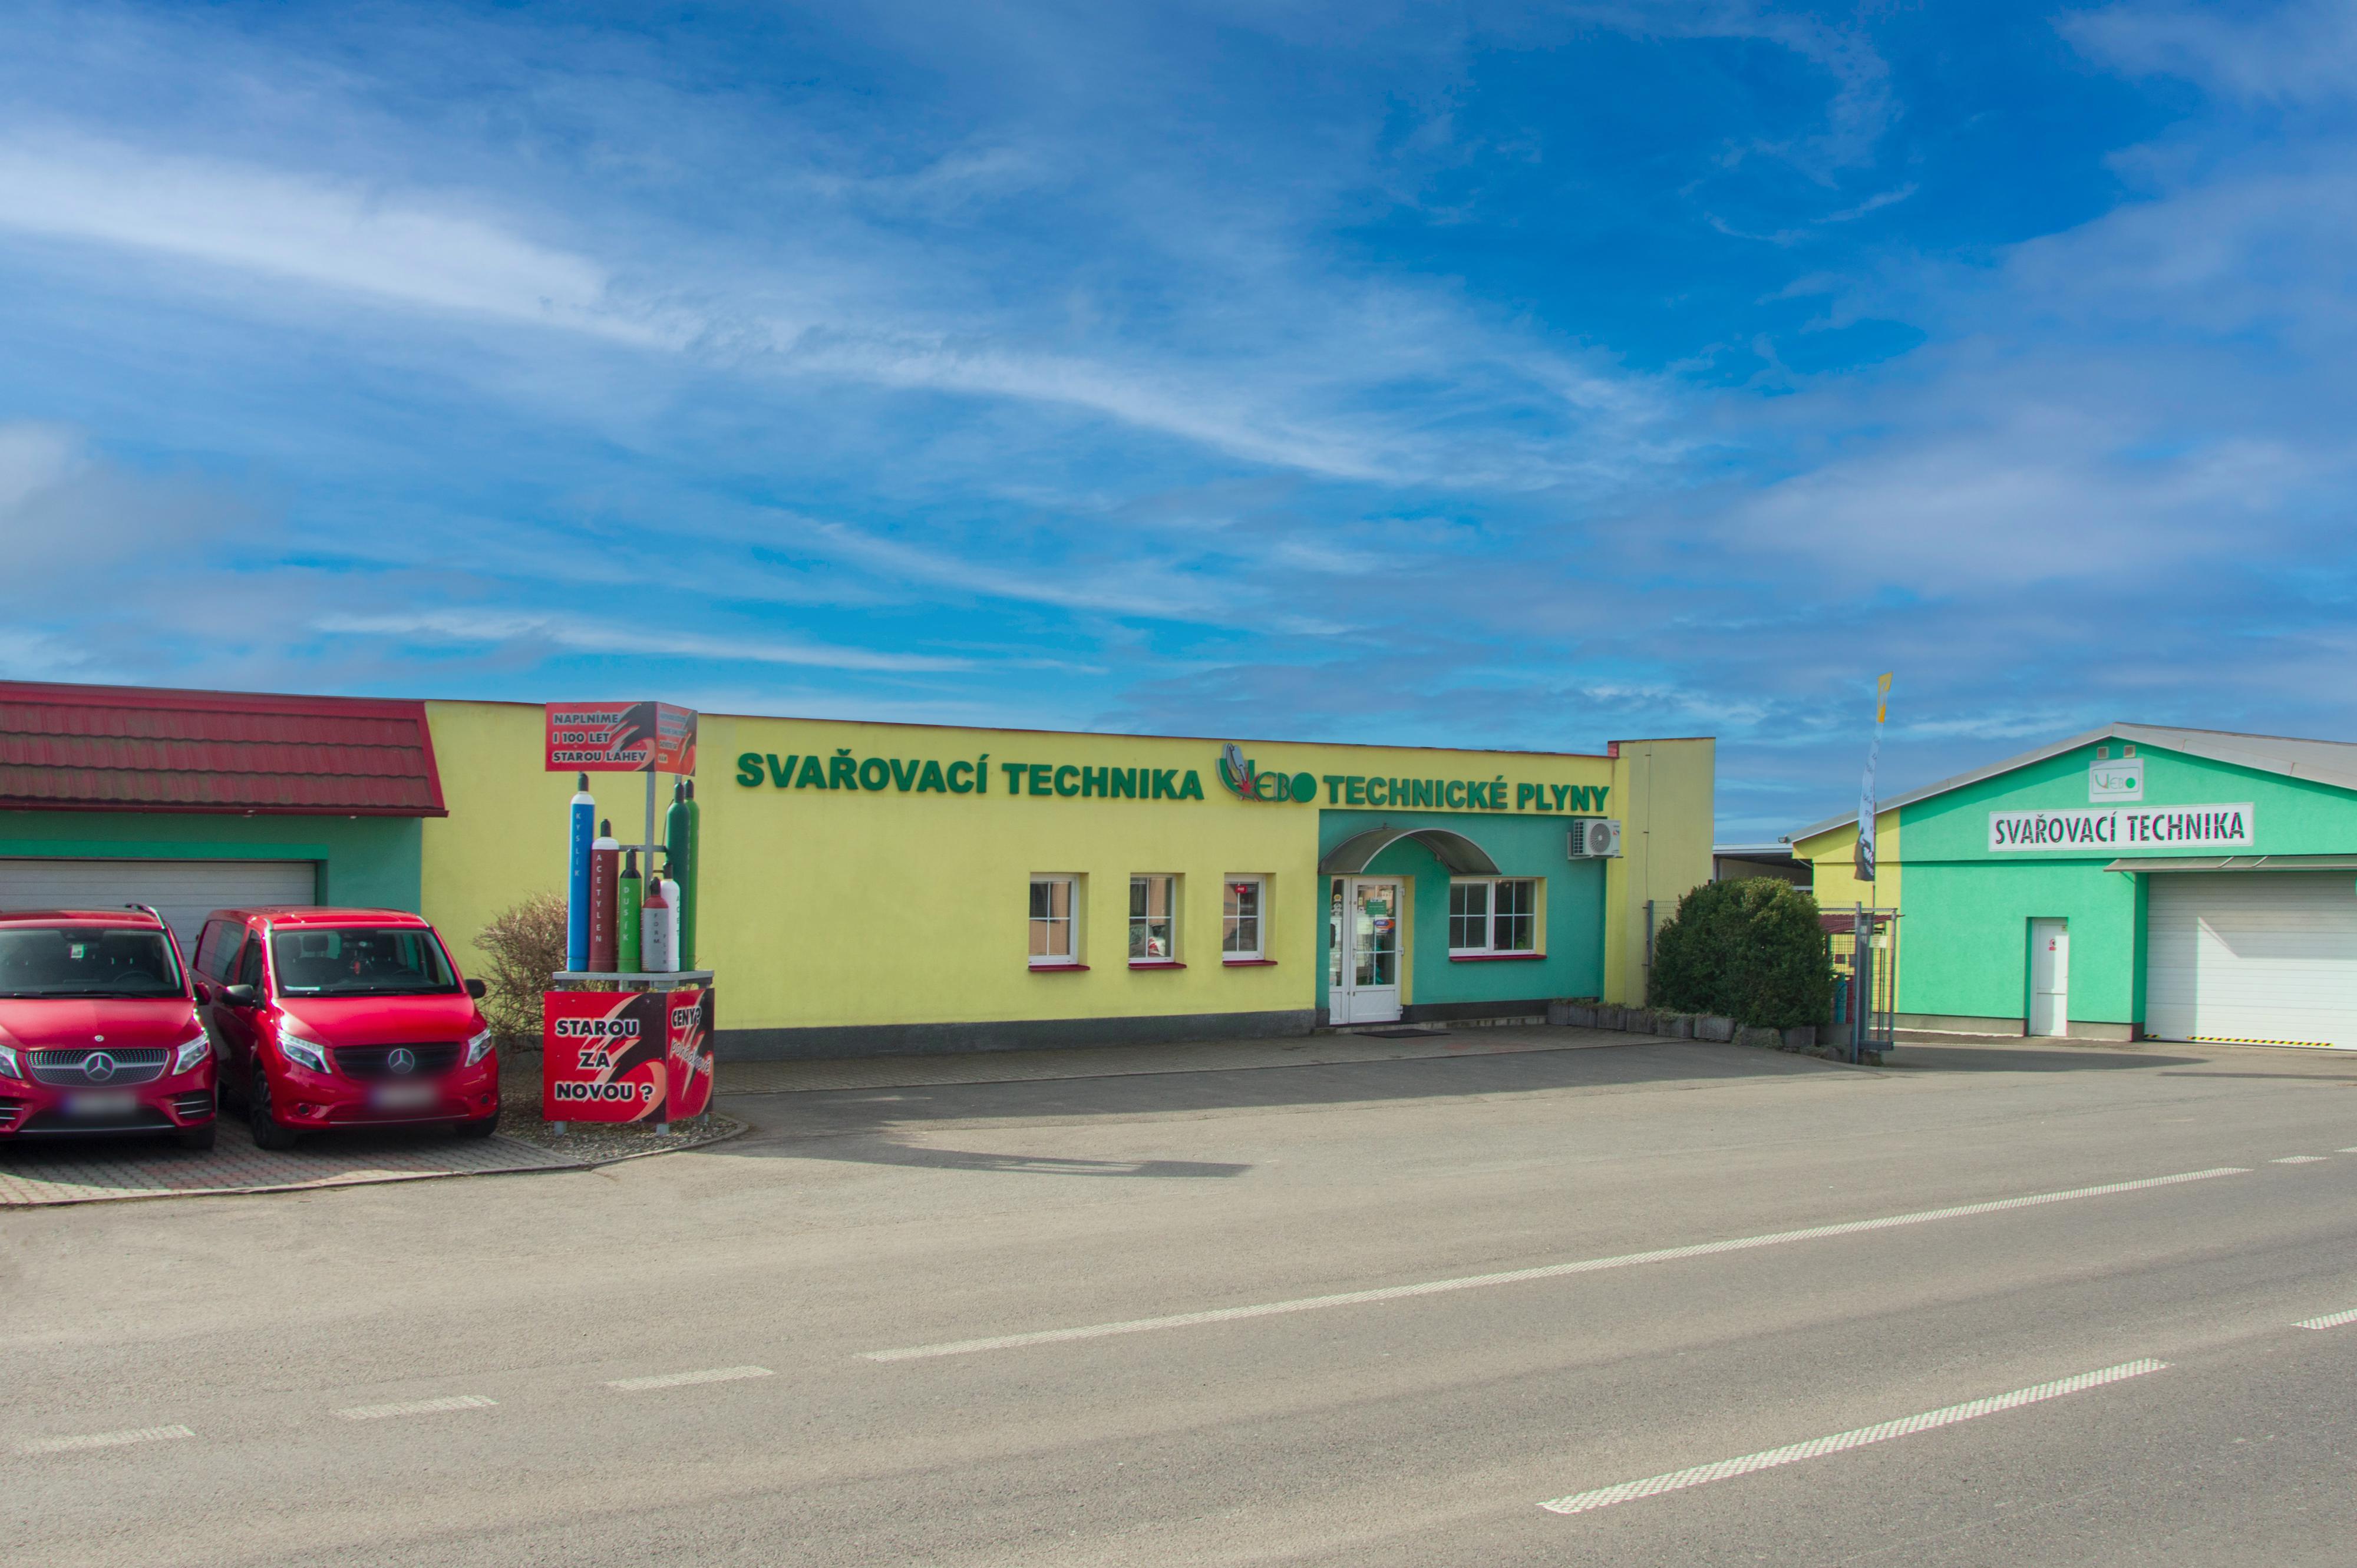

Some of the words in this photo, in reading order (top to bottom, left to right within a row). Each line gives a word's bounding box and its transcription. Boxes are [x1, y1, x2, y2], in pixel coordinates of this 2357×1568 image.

[554, 711, 618, 724] NAPLNÍME
[553, 733, 557, 742] I
[563, 733, 583, 742] 100
[590, 733, 610, 742] LET
[553, 752, 601, 762] STAROU
[606, 750, 647, 762] LÁHEV
[737, 748, 990, 794] SVAŘOVACÍ
[1002, 763, 1204, 800] TECHNIKA
[1323, 775, 1508, 810] TECHNICKÉ
[1518, 783, 1610, 812] PLYNY
[1995, 811, 2118, 844] SVAŘOVACÍ
[2127, 811, 2244, 841] TECHNIKA
[672, 1008, 701, 1027] CENY?
[556, 1020, 638, 1036] STAROU
[580, 1052, 610, 1067] ZA
[556, 1084, 633, 1100] NOVOU
[641, 1084, 653, 1101] ?
